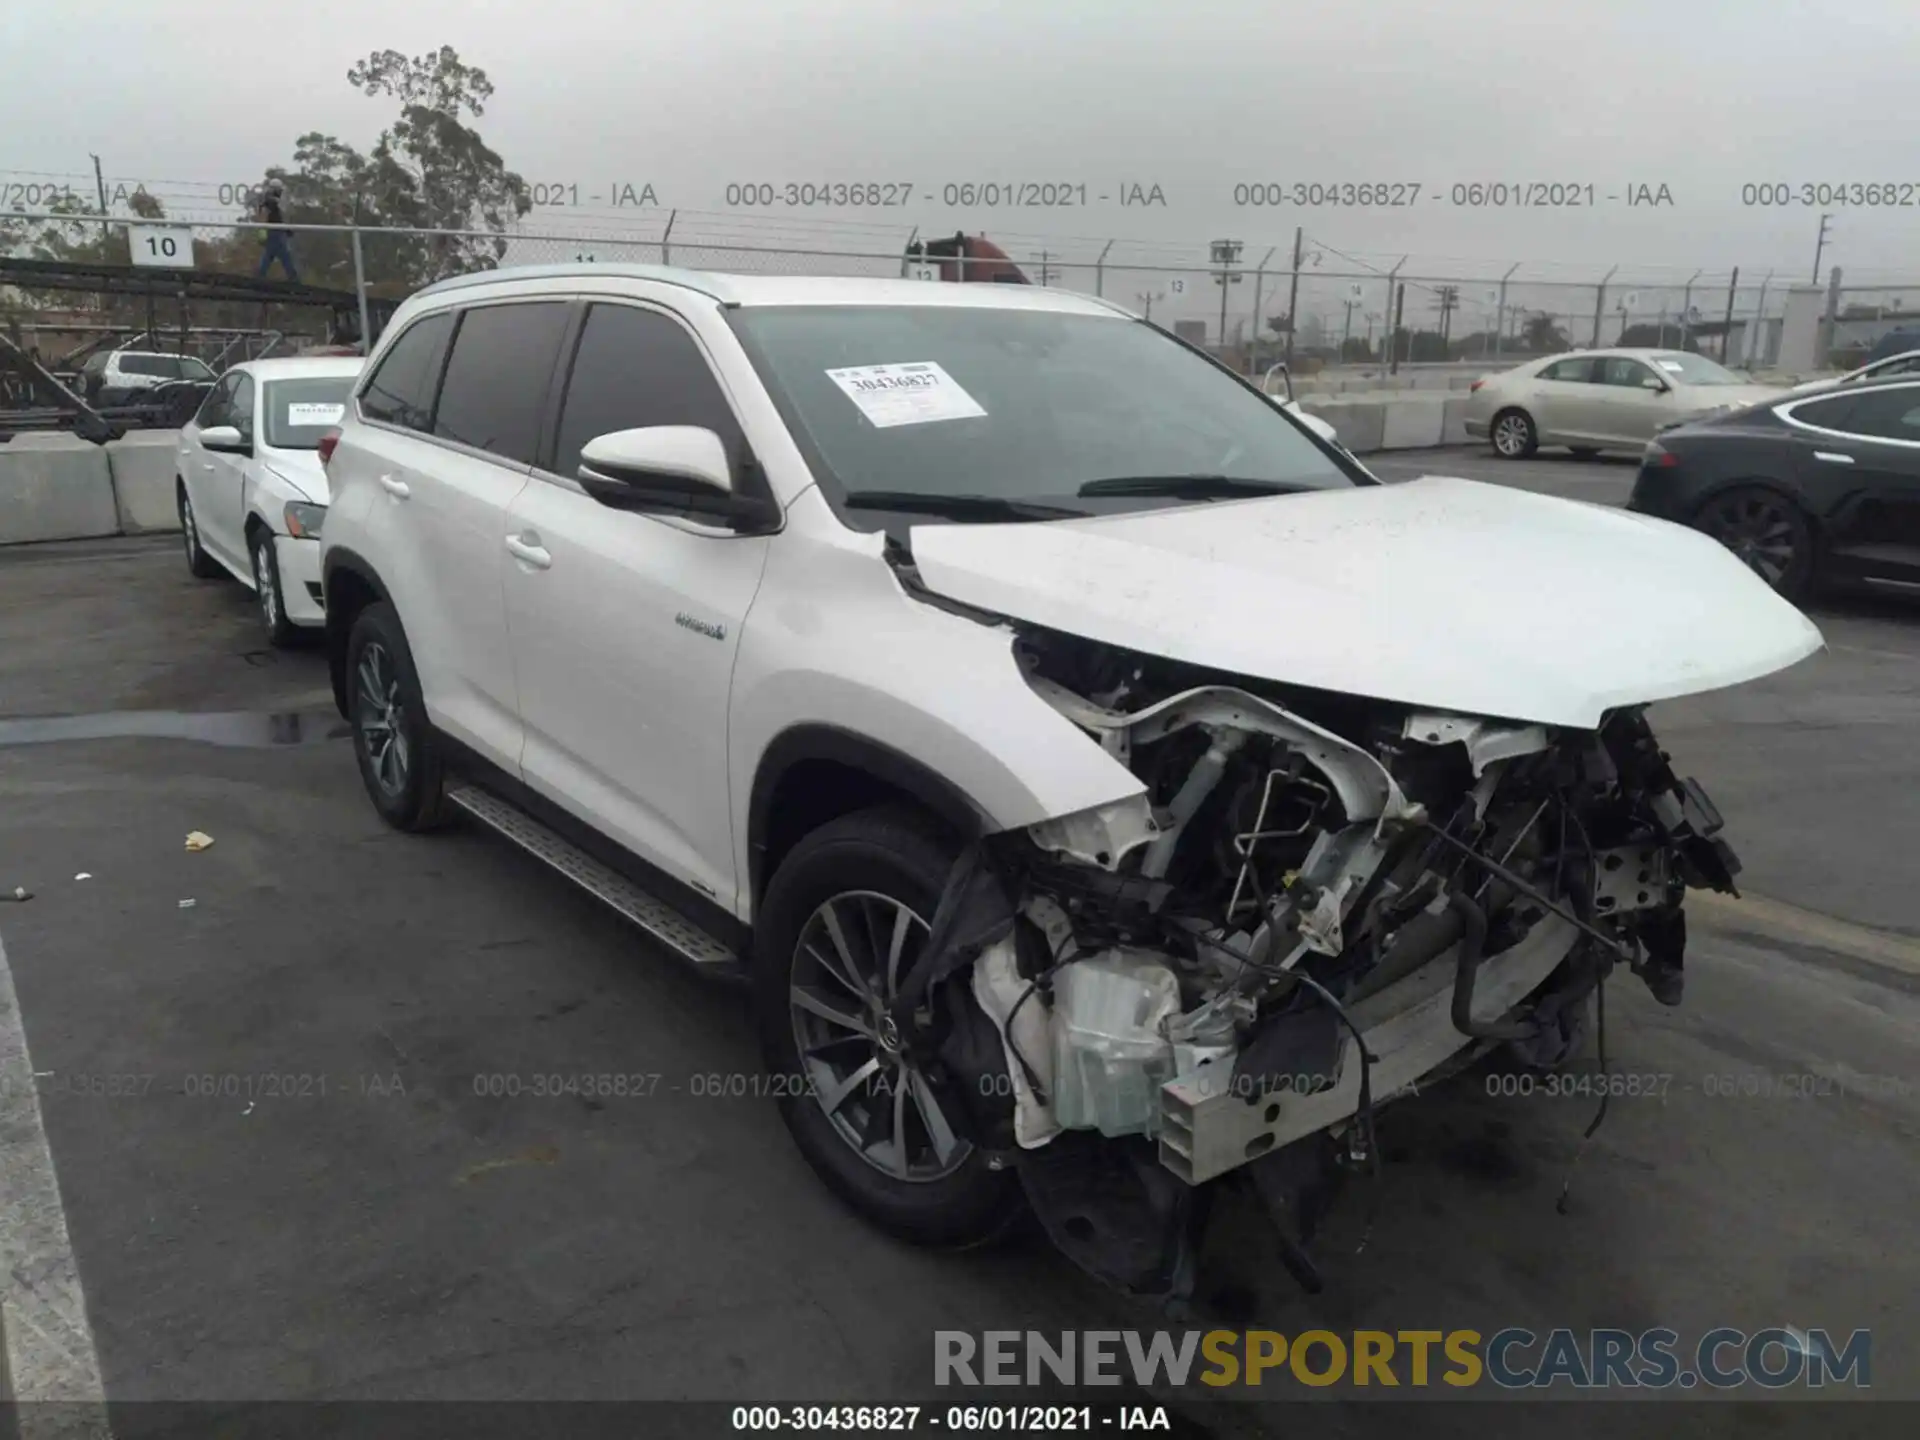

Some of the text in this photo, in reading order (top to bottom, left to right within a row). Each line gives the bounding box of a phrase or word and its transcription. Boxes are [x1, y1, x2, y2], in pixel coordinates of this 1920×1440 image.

[145, 236, 177, 258] 10
[1171, 279, 1184, 293] 13
[850, 373, 940, 392] 30436827
